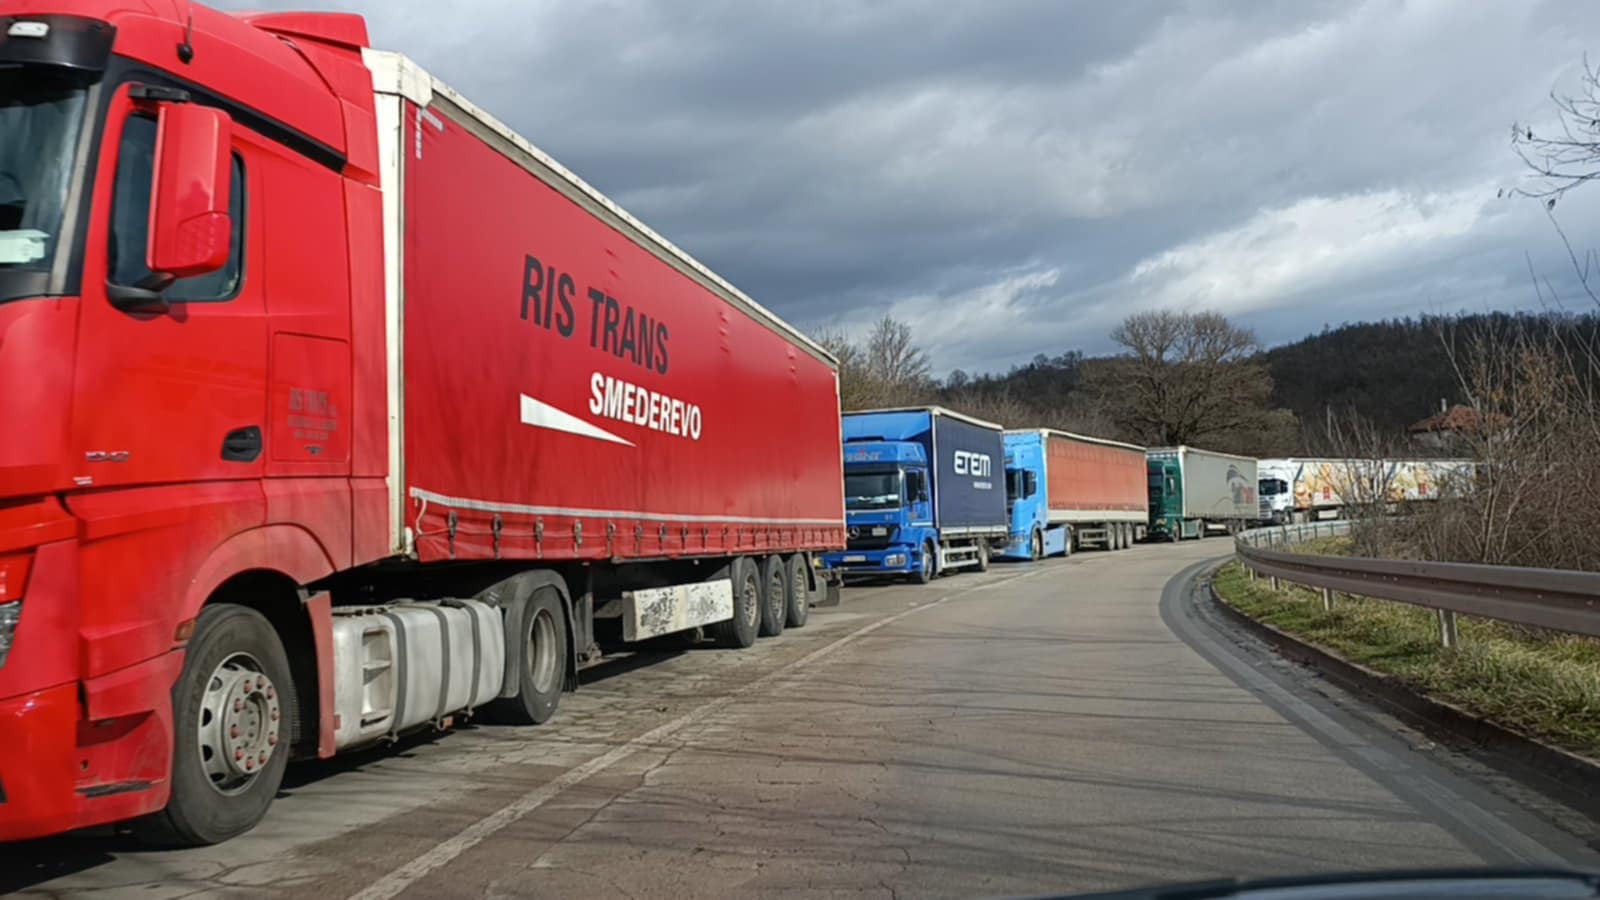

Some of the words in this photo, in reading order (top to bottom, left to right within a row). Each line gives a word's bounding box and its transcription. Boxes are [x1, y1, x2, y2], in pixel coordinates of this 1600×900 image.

[520, 254, 576, 338] RIS
[588, 286, 669, 375] TRANS
[589, 371, 702, 441] SMEDEREVO
